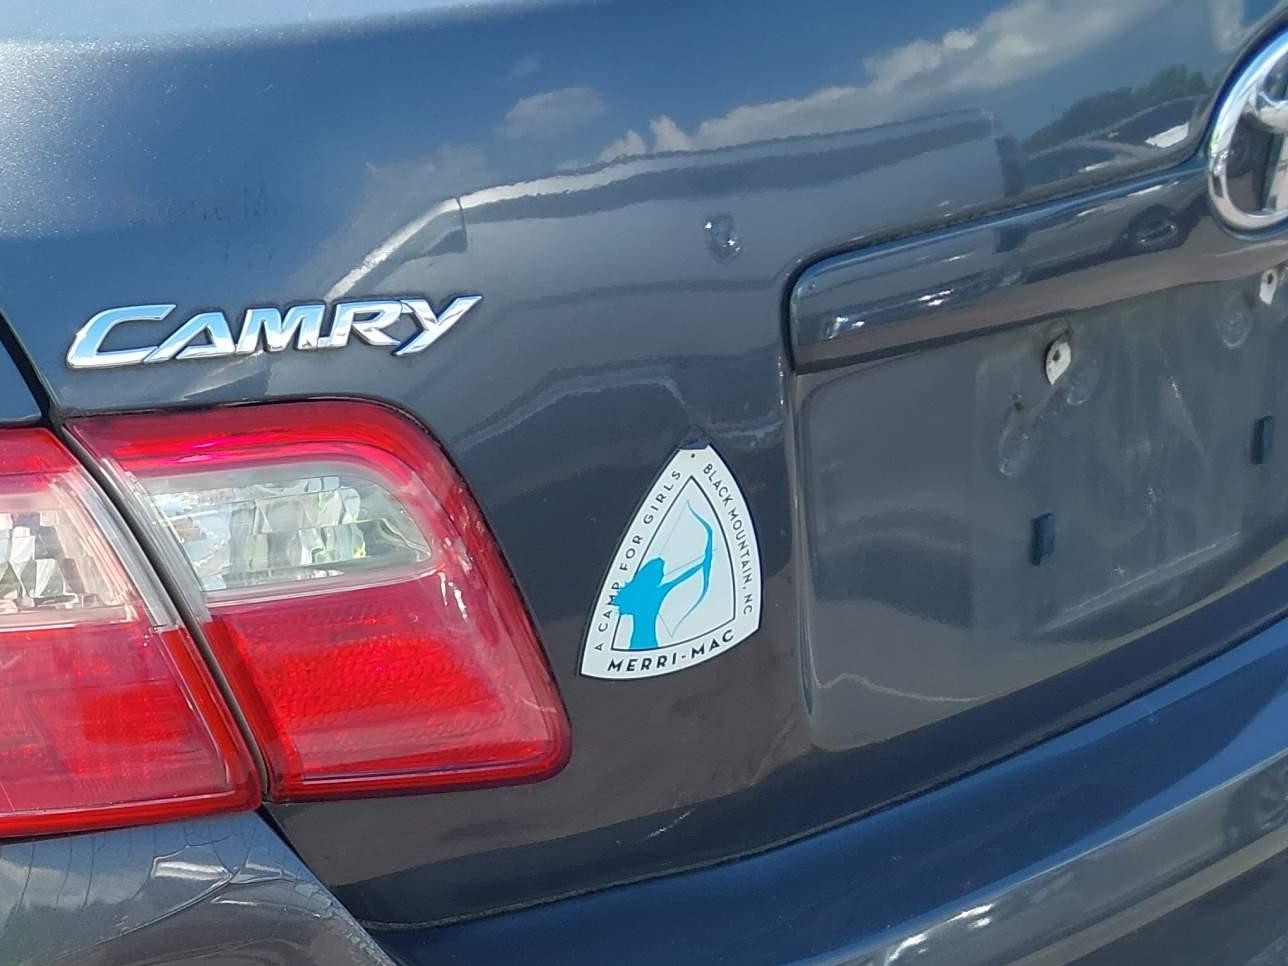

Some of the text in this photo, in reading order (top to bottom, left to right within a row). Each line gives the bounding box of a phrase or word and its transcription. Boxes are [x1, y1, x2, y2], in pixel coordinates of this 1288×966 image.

[65, 295, 483, 369] CAMRY
[594, 470, 681, 651] A CAMP FOR GIRLS
[703, 463, 753, 615] BLACK MOUNTAIN, NC
[607, 629, 735, 672] MERRI-MAC
